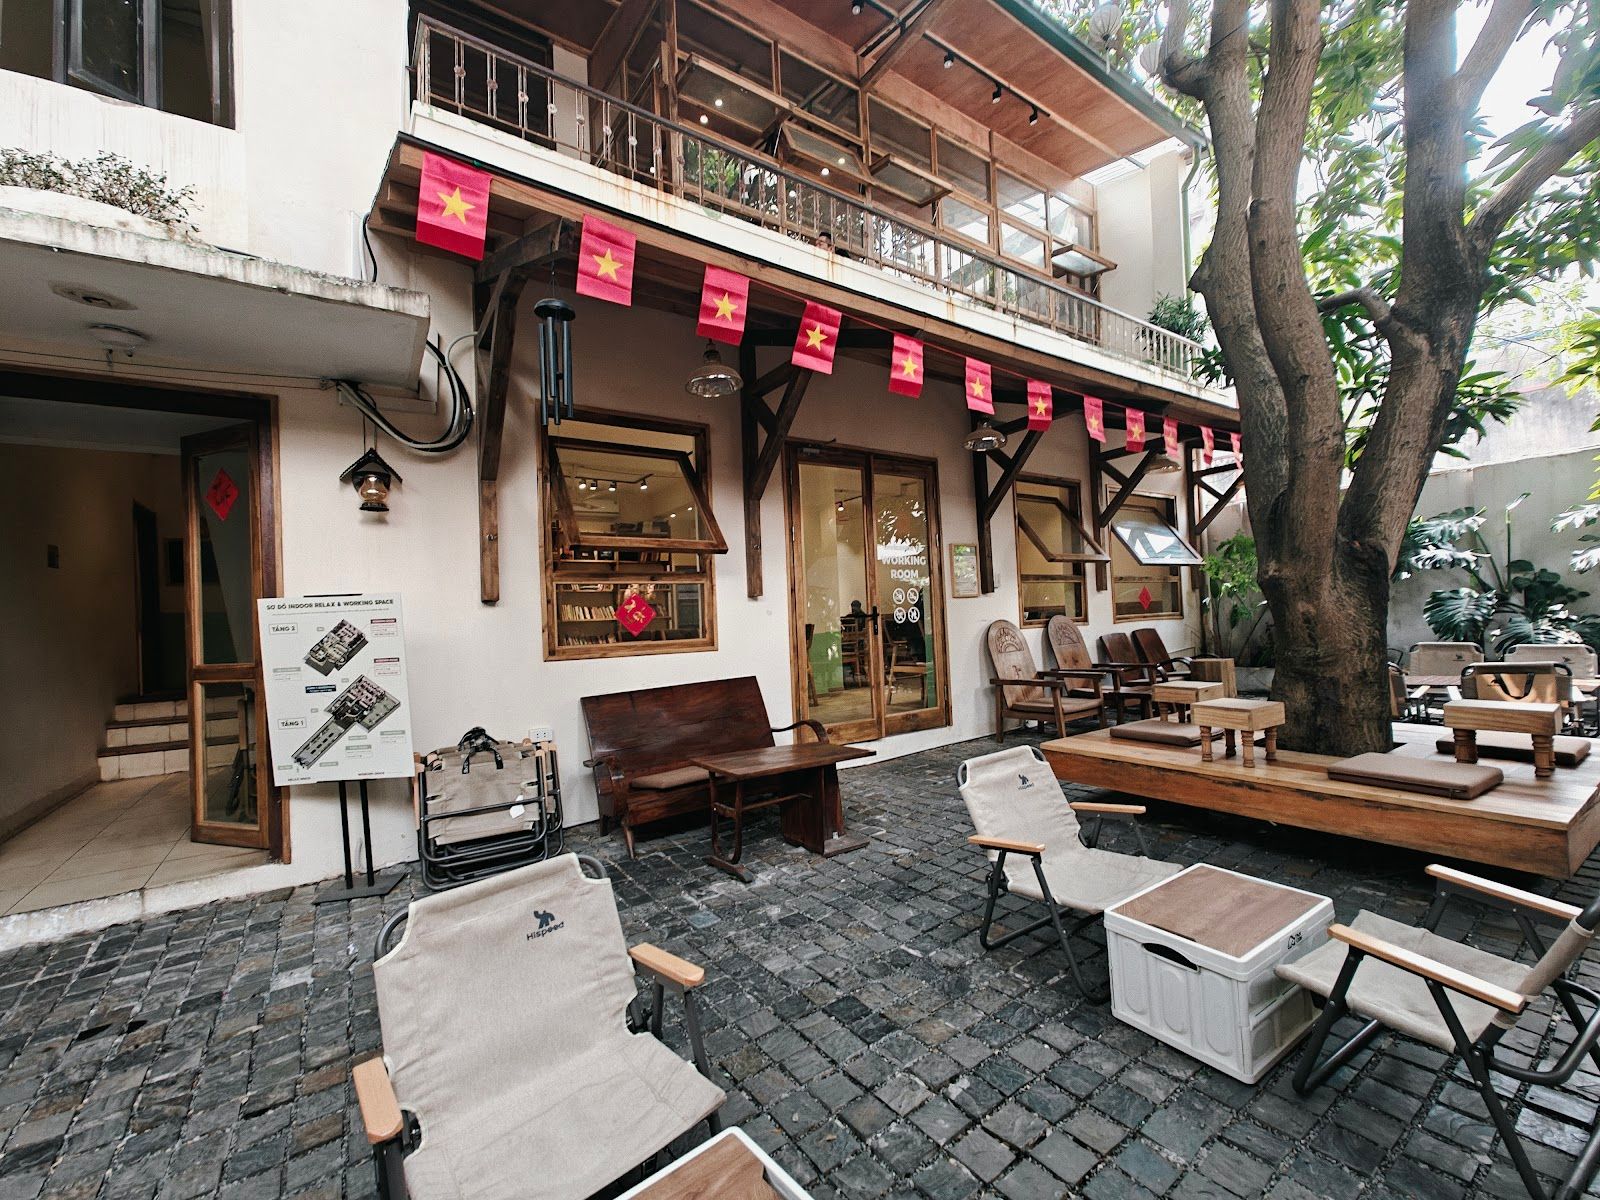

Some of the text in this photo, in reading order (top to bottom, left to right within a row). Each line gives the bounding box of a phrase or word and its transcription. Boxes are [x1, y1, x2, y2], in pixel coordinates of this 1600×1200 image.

[881, 556, 926, 565] WORKING
[890, 569, 919, 579] ROOM
[526, 921, 564, 941] Hispeed
